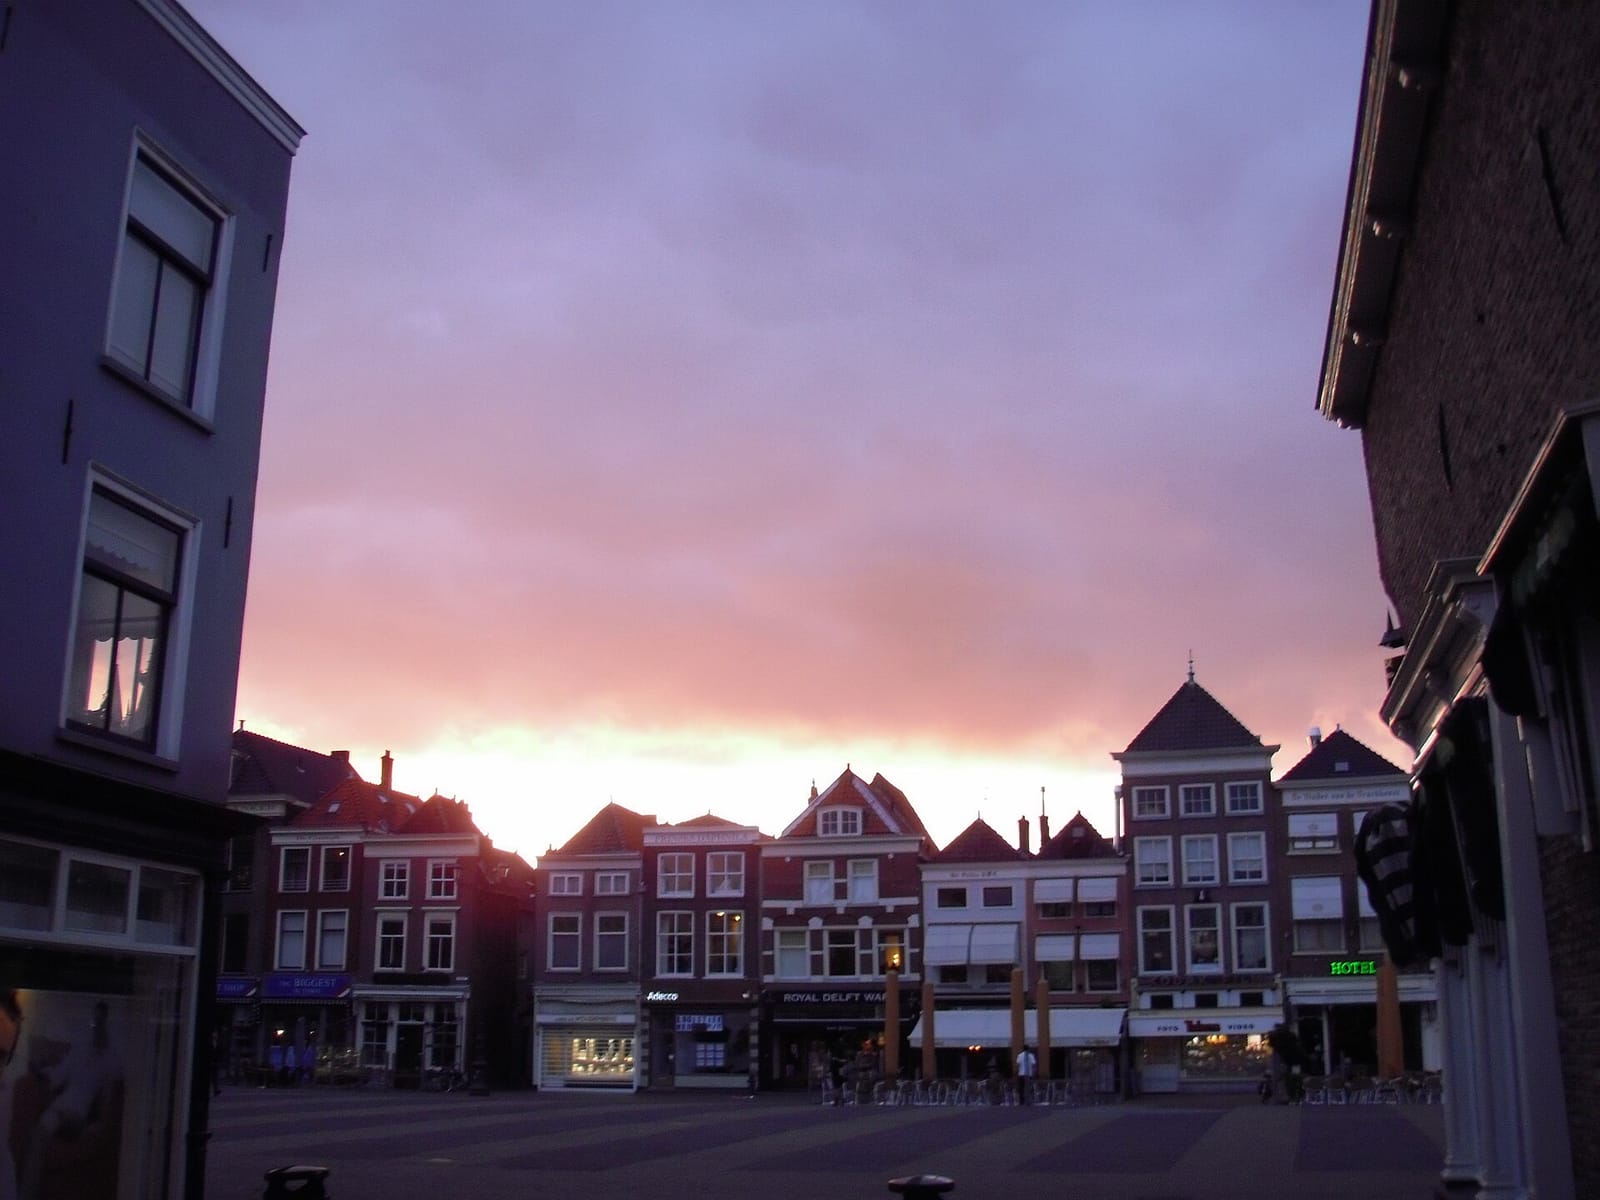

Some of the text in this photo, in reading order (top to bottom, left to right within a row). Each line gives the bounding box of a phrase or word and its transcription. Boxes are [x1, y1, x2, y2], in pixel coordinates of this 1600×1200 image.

[1330, 961, 1376, 974] HOTEL
[294, 978, 336, 988] BIGGEST
[647, 991, 679, 1001] Adecco
[783, 993, 819, 1002] ROYAL
[822, 993, 861, 1002] DELFT
[1227, 1023, 1255, 1031] VIDEO
